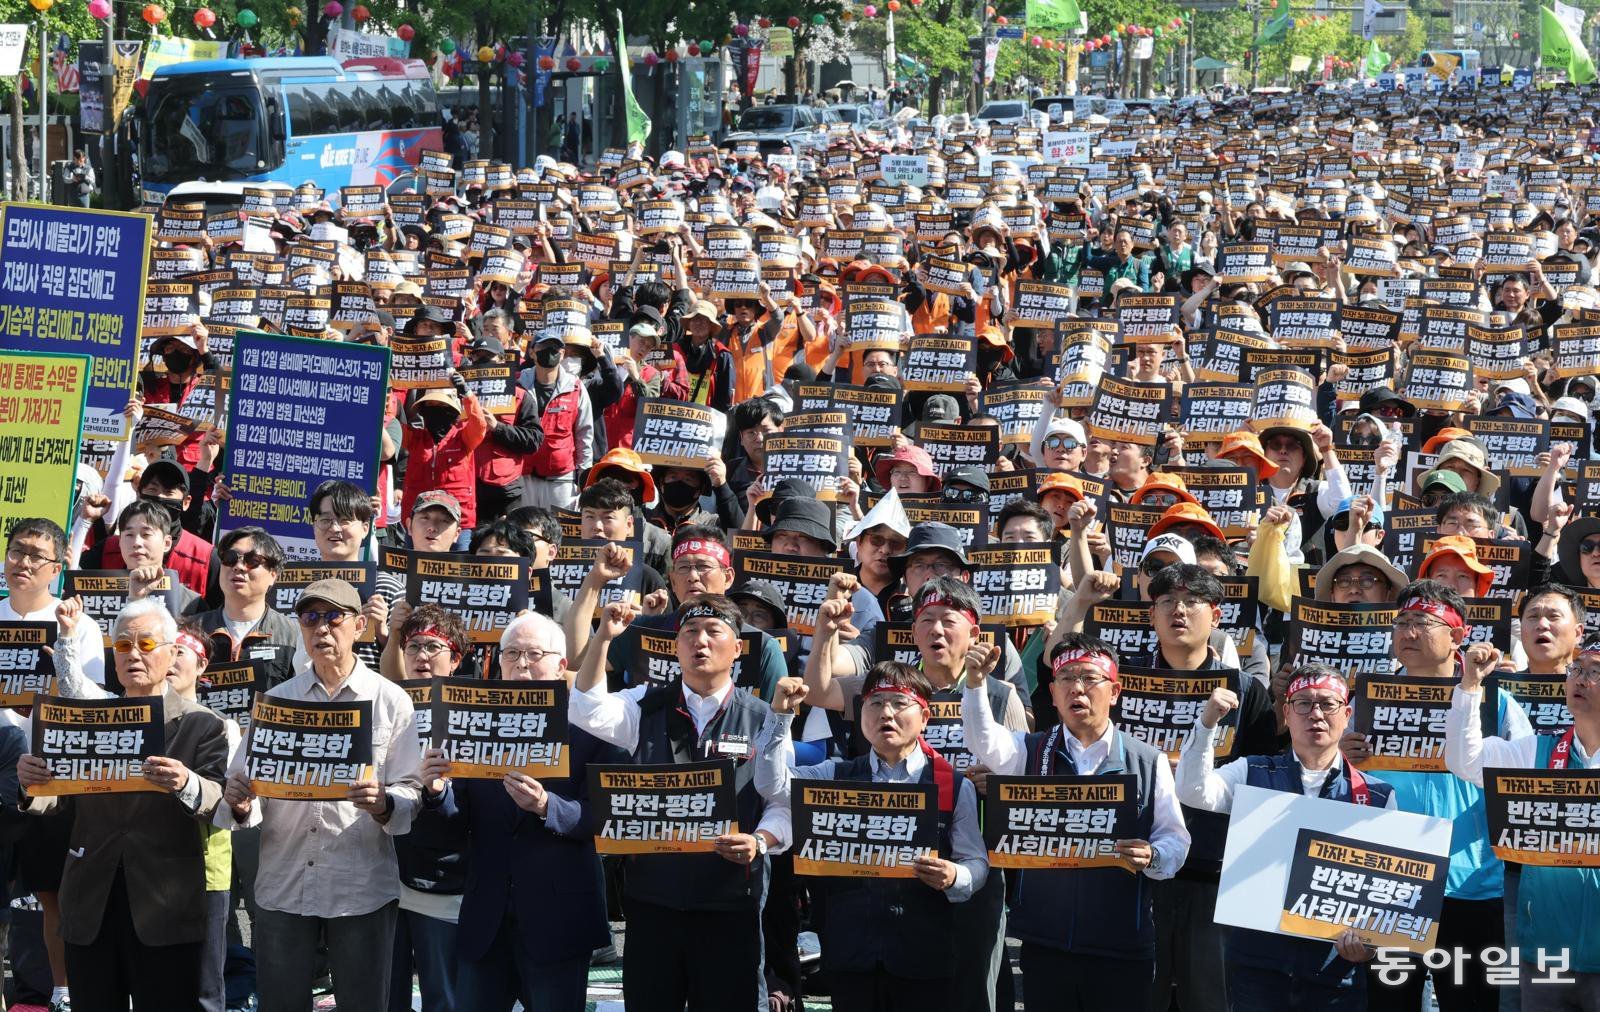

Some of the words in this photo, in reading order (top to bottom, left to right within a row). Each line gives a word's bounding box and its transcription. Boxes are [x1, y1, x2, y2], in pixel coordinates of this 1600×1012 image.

[6, 218, 43, 250] 모회사
[45, 221, 94, 255] 배불리기
[96, 225, 120, 258] 위한
[2, 261, 39, 294] 자회사
[42, 264, 66, 296] 직원
[68, 267, 116, 300] 집단해고
[541, 273, 578, 284] 반전·평화
[1019, 294, 1069, 309] 반전·평화
[0, 305, 35, 337] 기습적
[37, 308, 84, 341] 정리해고
[86, 312, 123, 345] 자행한
[851, 314, 899, 328] 반전·평화
[1120, 309, 1171, 322] 반전·평화
[1279, 312, 1332, 326] 반전·평화
[1341, 319, 1390, 336] 반전·평화
[1469, 341, 1520, 357] 반전·평화
[243, 348, 260, 367] 12월
[261, 351, 278, 370] 12일
[279, 351, 361, 378] 설비매각(모베이스전자
[362, 360, 382, 381] 구입)
[392, 353, 445, 367] 반전·평화
[908, 351, 966, 367] 반전·평화
[14, 364, 45, 390] 통제로
[47, 365, 77, 392] 수익은
[1411, 368, 1466, 387] 반전·평화
[241, 374, 257, 393] 12월
[258, 376, 277, 394] 26일
[279, 377, 318, 399] 이사회에서
[319, 381, 351, 403] 파산절차
[353, 385, 369, 404] 의결
[1258, 385, 1312, 404] 반전·평화
[21, 398, 62, 424] 가져가고
[238, 399, 254, 417] 12월
[256, 401, 275, 420] 29일
[276, 403, 293, 422] 법원
[294, 404, 326, 425] 파산신청
[1097, 394, 1160, 419] 반전·평화
[1190, 400, 1251, 416] 반전·평화
[236, 423, 248, 441] 1월
[249, 426, 267, 444] 22일
[269, 428, 305, 448] 10시30분
[306, 431, 321, 449] 법원
[323, 432, 355, 453] 파산선고
[645, 418, 712, 442] 반전·평화
[923, 428, 940, 437] 가자!
[942, 430, 965, 440] 노동자
[967, 431, 987, 441] 시대!
[35, 437, 73, 465] 넘겨졌다
[768, 438, 785, 449] 가자!
[787, 439, 816, 450] 노동자
[817, 439, 838, 450] 시대!
[923, 443, 987, 462] 반전·평화
[234, 448, 245, 467] 1월
[246, 450, 265, 469] 22일
[266, 452, 346, 478] 직원/협력업체/은행에
[348, 461, 364, 479] 통보
[766, 454, 837, 473] 반전·평화
[4, 476, 27, 503] 파산!
[231, 473, 247, 491] 도둑
[248, 475, 272, 495] 파산은
[274, 478, 307, 499] 위법이다.
[998, 477, 1023, 488] 시대!
[1192, 475, 1221, 485] 노동자
[1222, 475, 1243, 484] 시대!
[269, 502, 300, 523] 모베이스
[921, 511, 950, 522] 노동자
[952, 512, 975, 522] 시대!
[1113, 509, 1130, 520] 가자!
[972, 554, 991, 564] 가자!
[995, 552, 1021, 563] 노동자
[1024, 551, 1046, 562] 시대!
[1486, 548, 1514, 559] 시대!
[421, 561, 446, 574] 가자!
[448, 562, 483, 576] 노동자
[486, 563, 512, 578] 시대!
[748, 560, 773, 572] 가자!
[776, 564, 810, 576] 노동자
[973, 569, 1047, 591] 반전·평화
[421, 580, 511, 608] 반전·평화
[1302, 607, 1323, 622] 가자!
[1326, 611, 1364, 625] 노동자
[16, 630, 40, 643] 시대!
[1301, 627, 1392, 655] 반전·평화
[1120, 676, 1147, 690] 가자!
[1150, 678, 1190, 693] 노동자
[1372, 684, 1401, 698] 가자!
[1405, 686, 1447, 700] 노동자
[446, 688, 472, 703] 가자!
[475, 691, 514, 705] 노동자
[516, 692, 548, 705] 시대!
[44, 706, 67, 722] 가자!
[70, 709, 110, 723] 노동자
[113, 708, 144, 722] 시대!
[257, 704, 277, 722] 가자!
[280, 710, 320, 726] 노동자
[321, 713, 353, 726] 시대!
[448, 710, 547, 738] 반전·평화
[42, 729, 144, 755] 반전·평화
[251, 727, 352, 759] 반전·평화
[439, 739, 562, 767] 사회대개혁!
[243, 756, 367, 787] 사회대개혁!
[605, 774, 637, 787] 가자!
[640, 775, 681, 787] 노동자
[684, 772, 716, 787] 시대!
[1005, 786, 1037, 800] 가자!
[1041, 786, 1084, 800] 노동자
[1085, 786, 1118, 800] 시대!
[1502, 778, 1535, 793] 가자!
[1538, 780, 1582, 794] 노동자
[610, 793, 716, 817] 반전·평화
[809, 790, 839, 805] 가자!
[843, 793, 884, 807] 노동자
[887, 794, 919, 809] 시대!
[812, 812, 917, 842] 반전·평화
[1008, 807, 1117, 834] 반전·평화
[1315, 842, 1347, 863] 가자!
[1349, 850, 1393, 871] 노동자
[1393, 860, 1428, 878] 시대!
[1310, 865, 1423, 910] 반전·평화
[1288, 893, 1433, 942] 사회대개혁!
